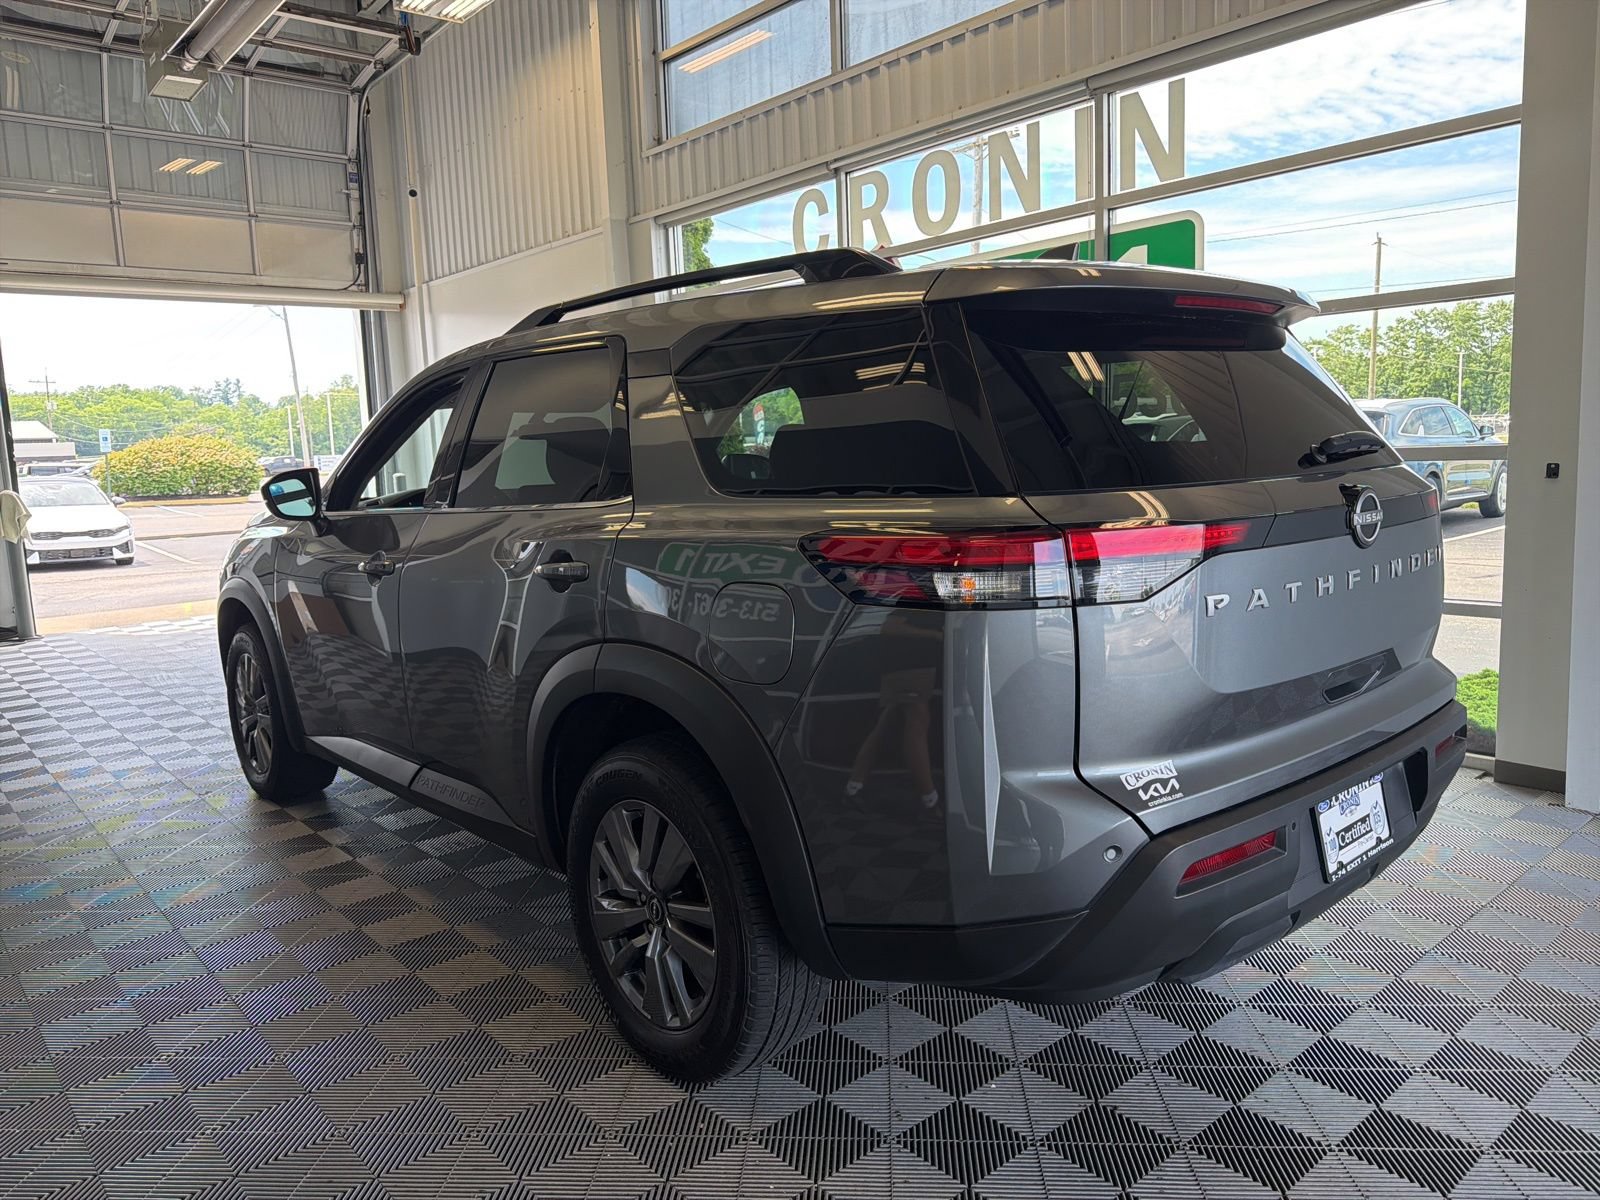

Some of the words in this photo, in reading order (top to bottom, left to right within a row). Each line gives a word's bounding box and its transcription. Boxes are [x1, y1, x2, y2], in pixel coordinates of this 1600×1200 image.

[792, 78, 1186, 254] CRONIN
[1355, 511, 1384, 524] NISSAN
[1124, 761, 1175, 788] CRONIN
[416, 774, 487, 809] PATHFINDER
[1137, 777, 1180, 801] KIA
[1338, 816, 1371, 846] Certified
